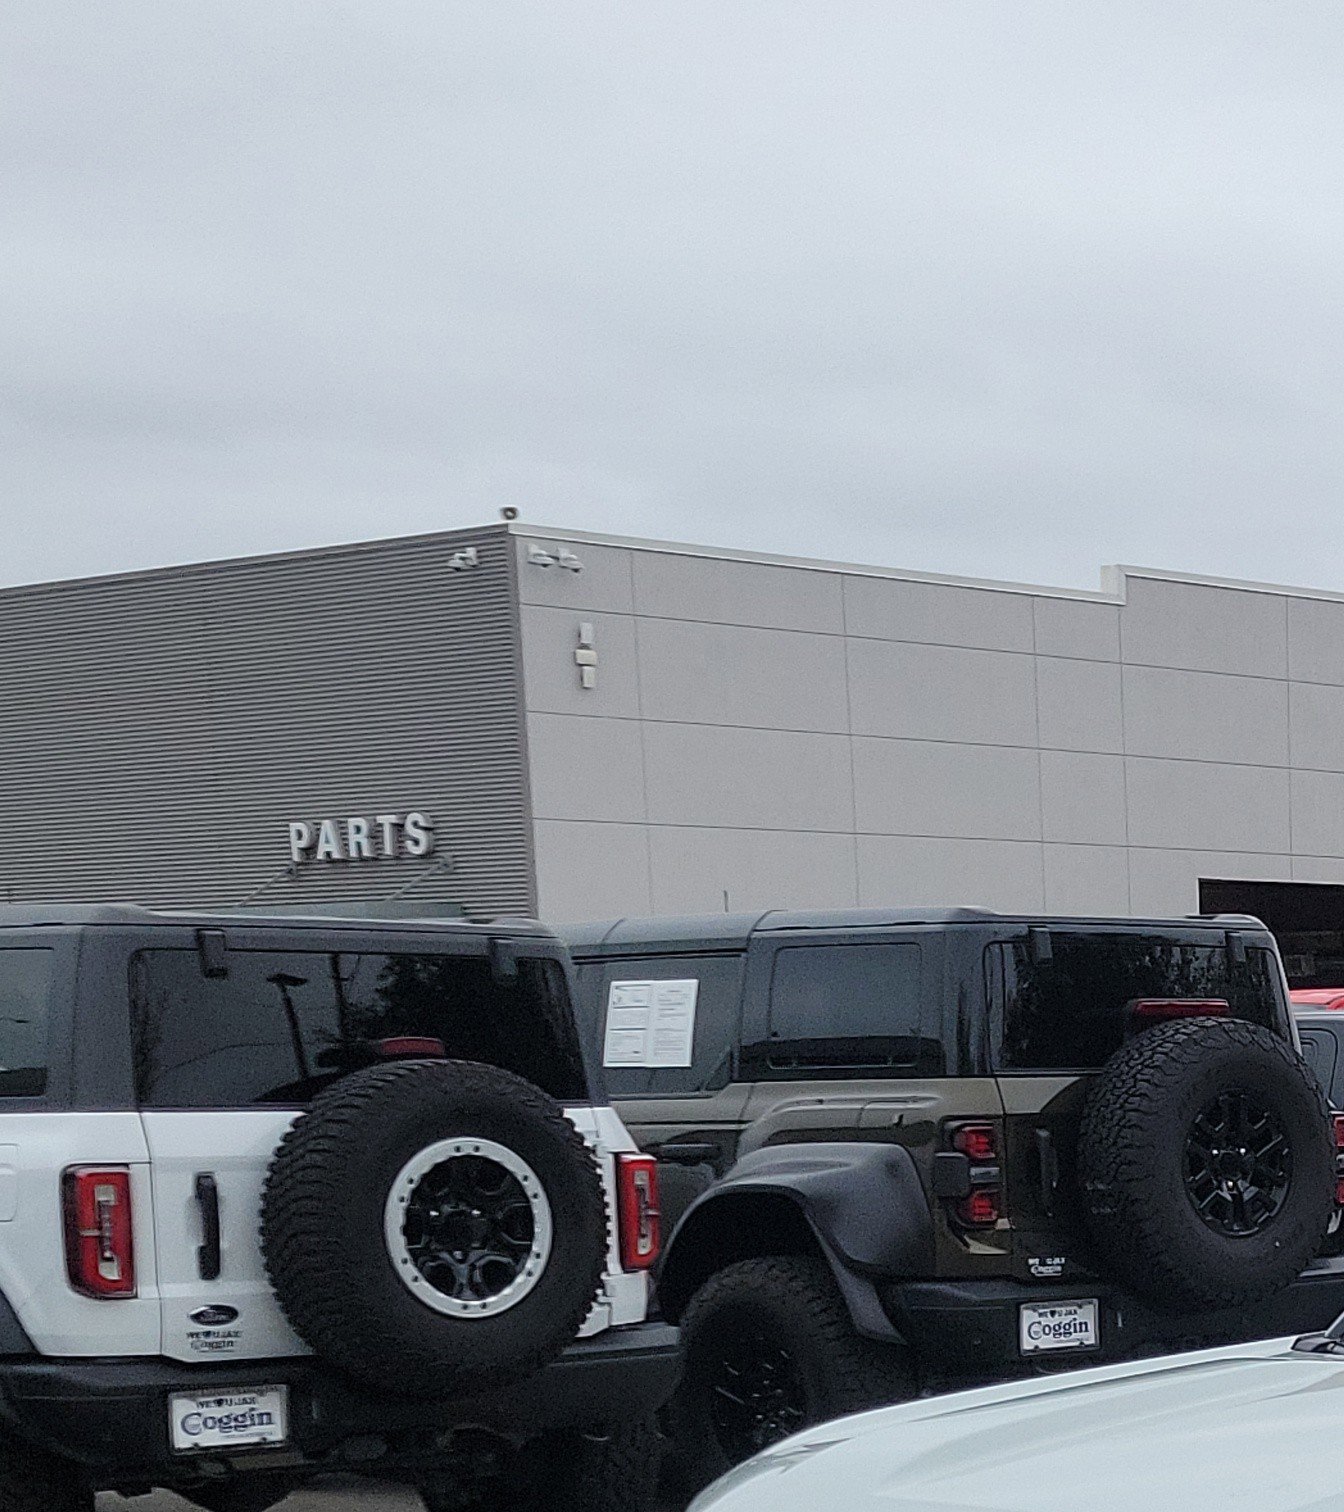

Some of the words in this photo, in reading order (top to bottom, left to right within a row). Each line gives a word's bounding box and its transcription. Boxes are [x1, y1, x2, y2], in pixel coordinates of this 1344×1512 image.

[289, 812, 430, 862] PARTS
[1028, 1317, 1089, 1340] Coggin
[181, 1407, 274, 1436] Coggin
